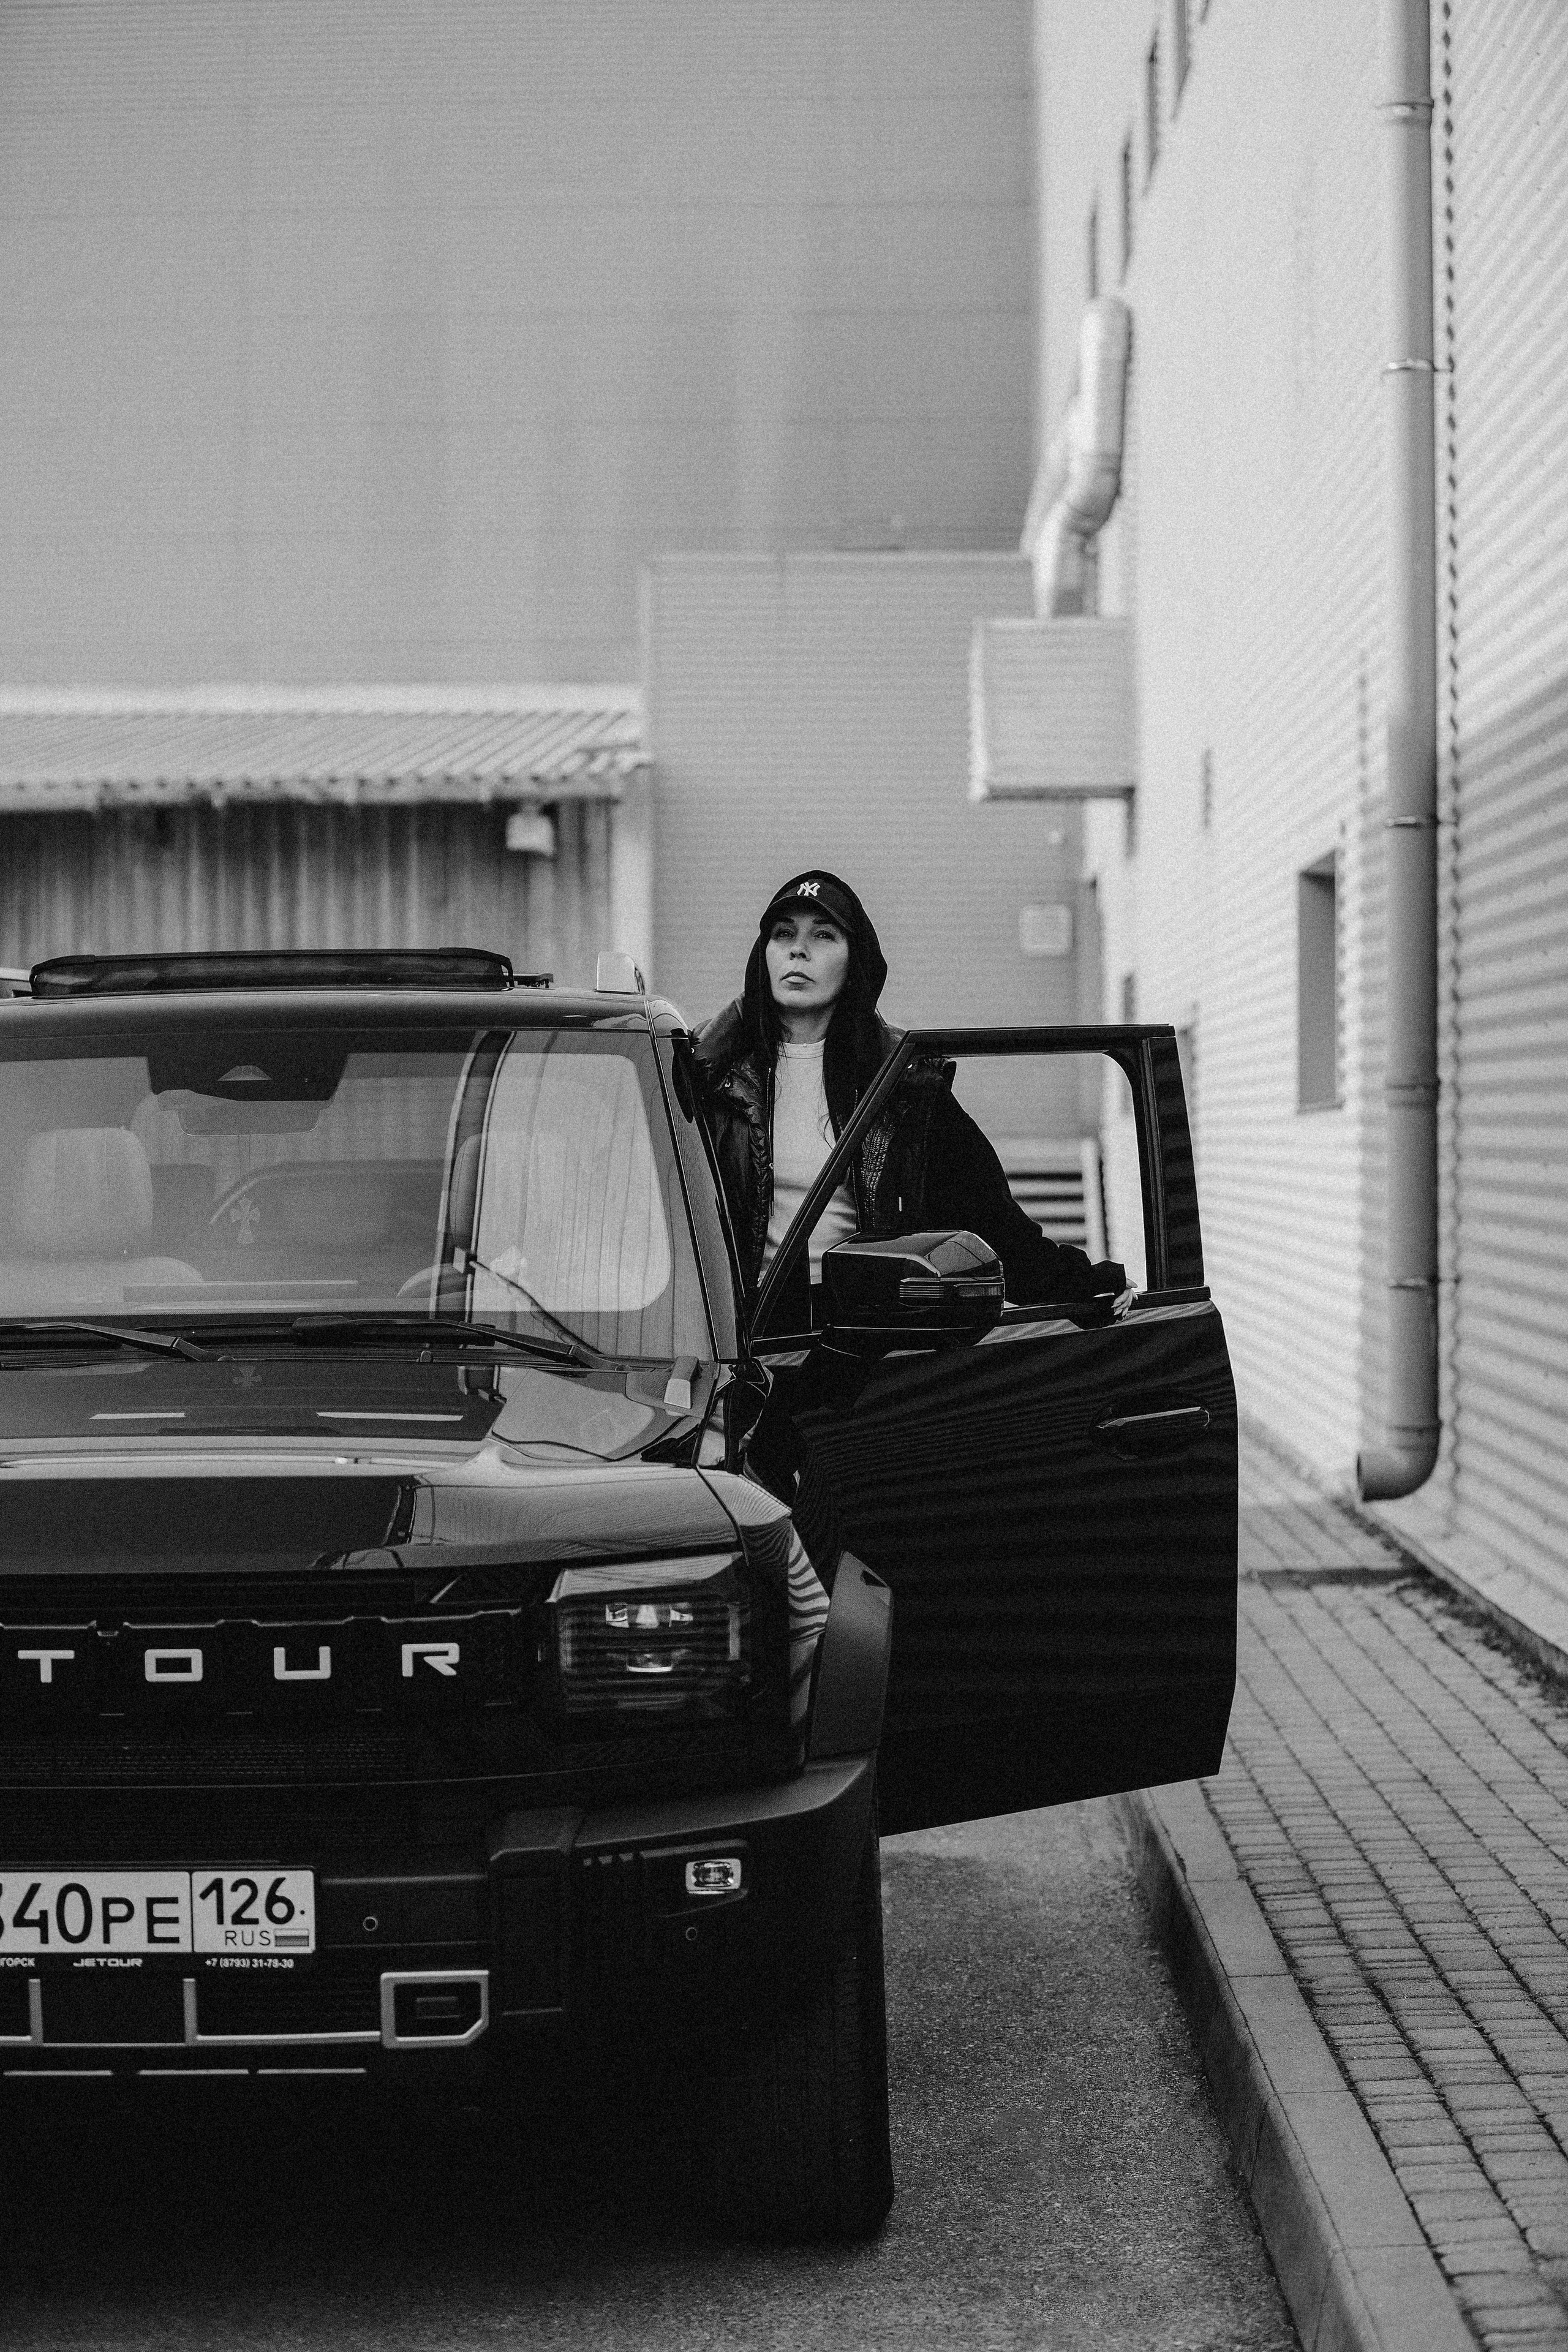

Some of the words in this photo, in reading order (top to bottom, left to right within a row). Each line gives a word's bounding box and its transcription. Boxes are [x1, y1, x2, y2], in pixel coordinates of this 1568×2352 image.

[18, 1643, 460, 1683] TOUR
[0, 1882, 179, 1944] 40PE
[225, 1930, 271, 1946] RUS
[73, 1958, 143, 1967] JETOUR
[205, 1958, 217, 1967] +7
